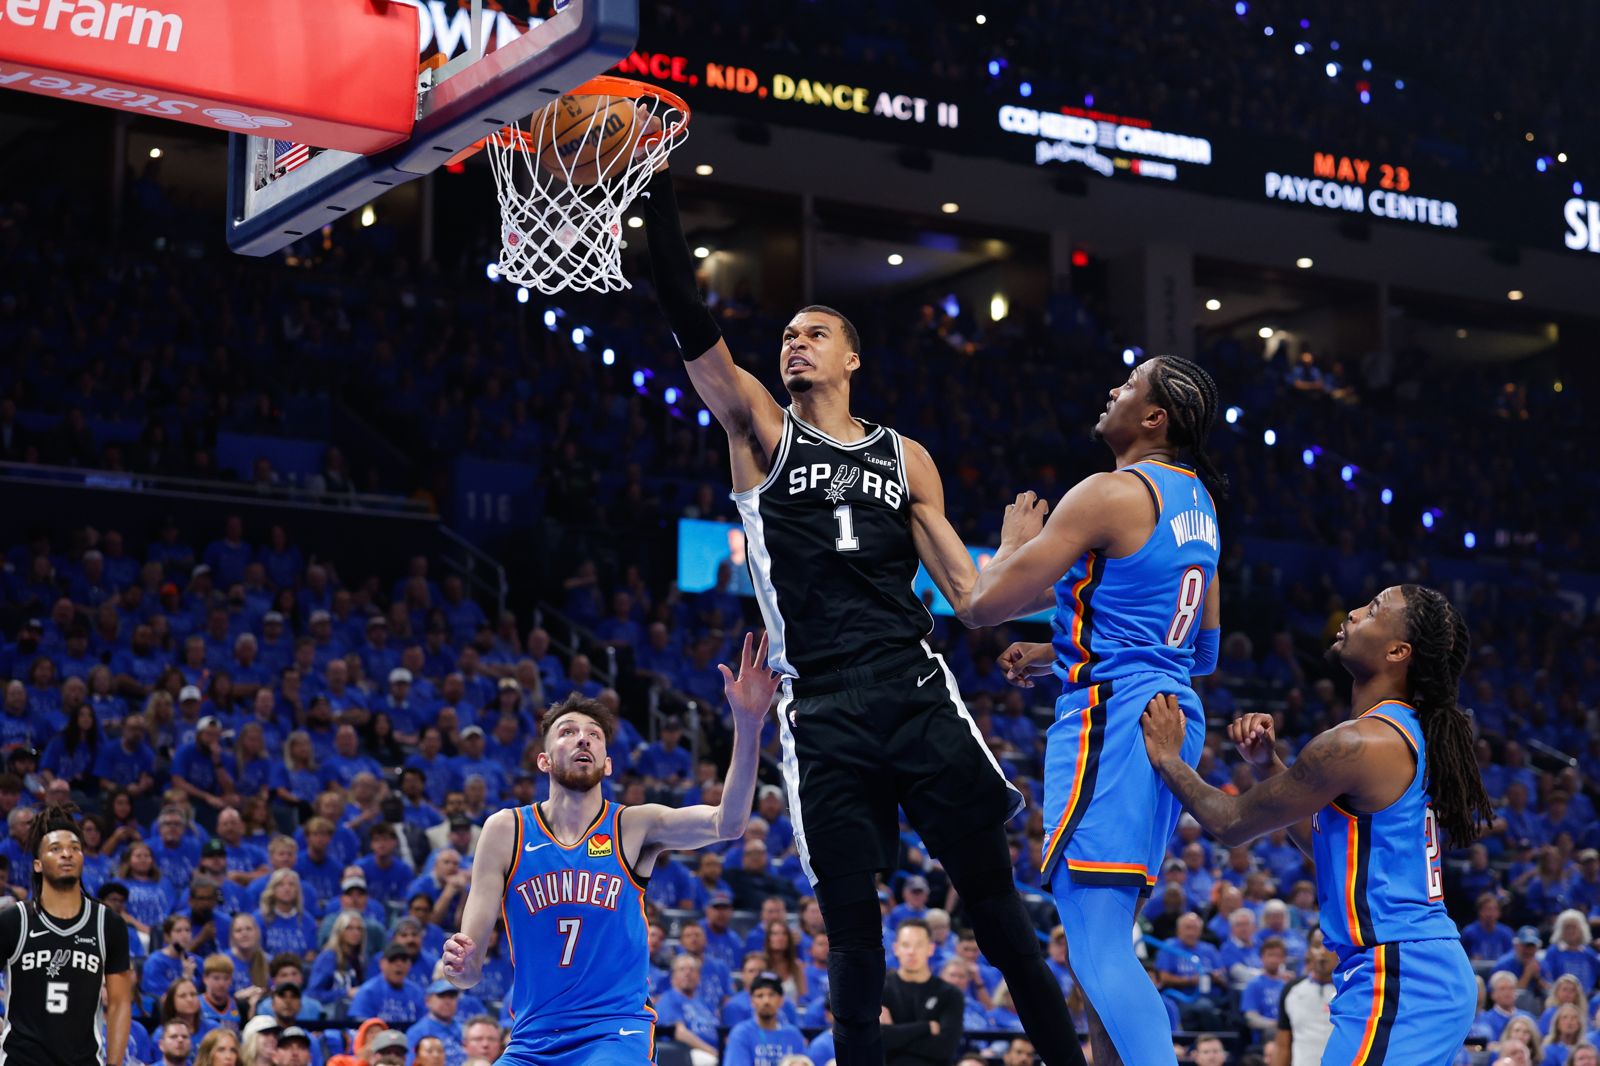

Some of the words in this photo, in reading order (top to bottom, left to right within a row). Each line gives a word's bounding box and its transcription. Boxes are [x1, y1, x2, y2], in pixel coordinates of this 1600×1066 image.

[0, 0, 183, 52] eFarm
[773, 73, 870, 113] DANCE
[873, 91, 928, 123] ACT
[1313, 151, 1371, 184] MAY
[1379, 163, 1411, 192] 23
[1264, 171, 1365, 213] PAYCOM
[1368, 189, 1459, 228] CENTER
[867, 456, 892, 467] LEDGER
[833, 503, 860, 551] 1
[1165, 564, 1205, 649] 8
[516, 869, 623, 917] THUNDER
[557, 916, 582, 968] 7
[45, 980, 70, 1014] 5
